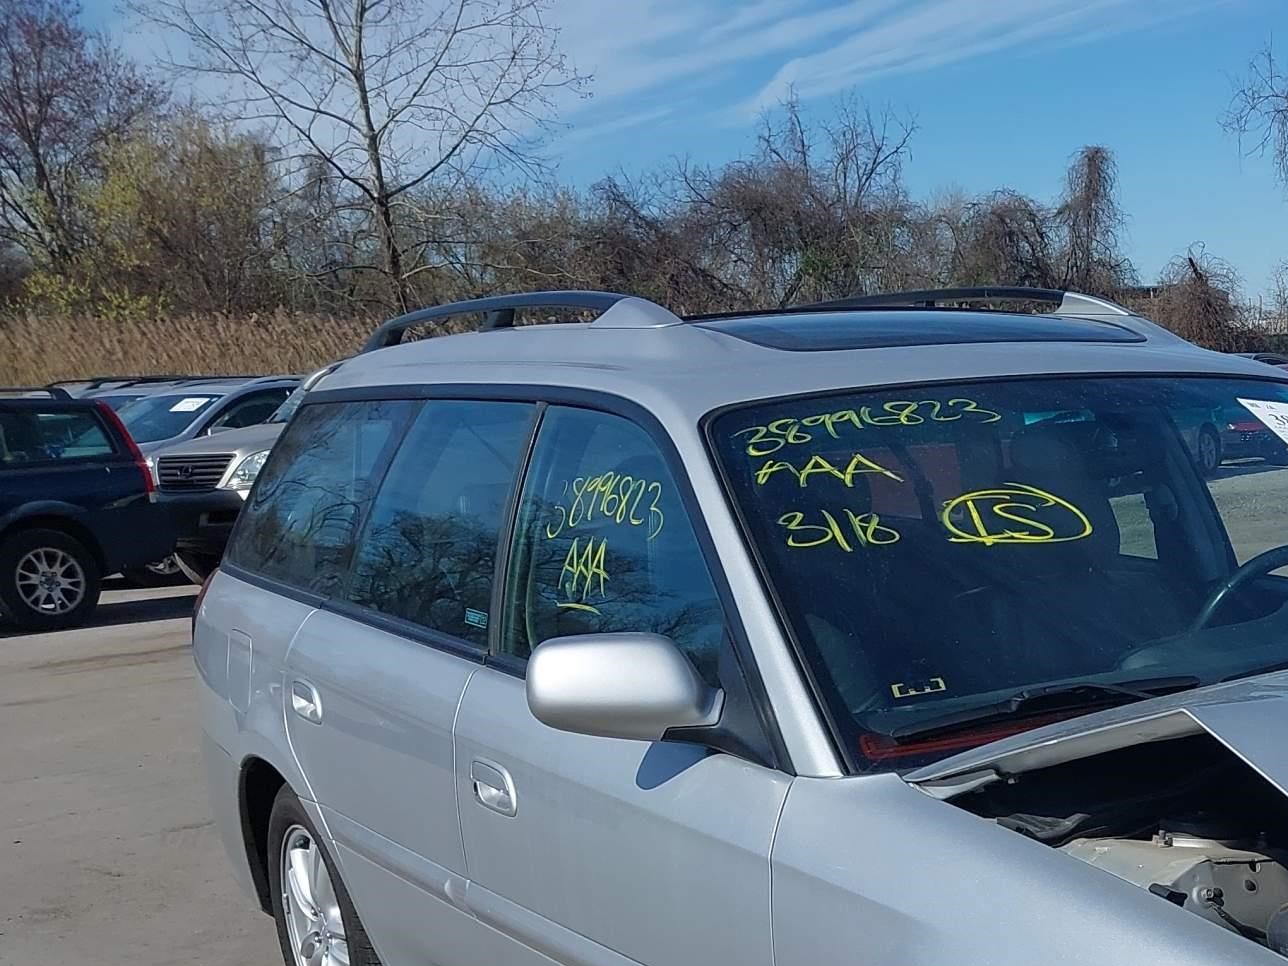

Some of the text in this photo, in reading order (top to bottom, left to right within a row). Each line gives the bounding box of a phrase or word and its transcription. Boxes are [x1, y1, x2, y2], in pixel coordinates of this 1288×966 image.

[730, 399, 1002, 456] 38996823
[754, 453, 905, 488] AAA
[558, 536, 610, 600] AAA
